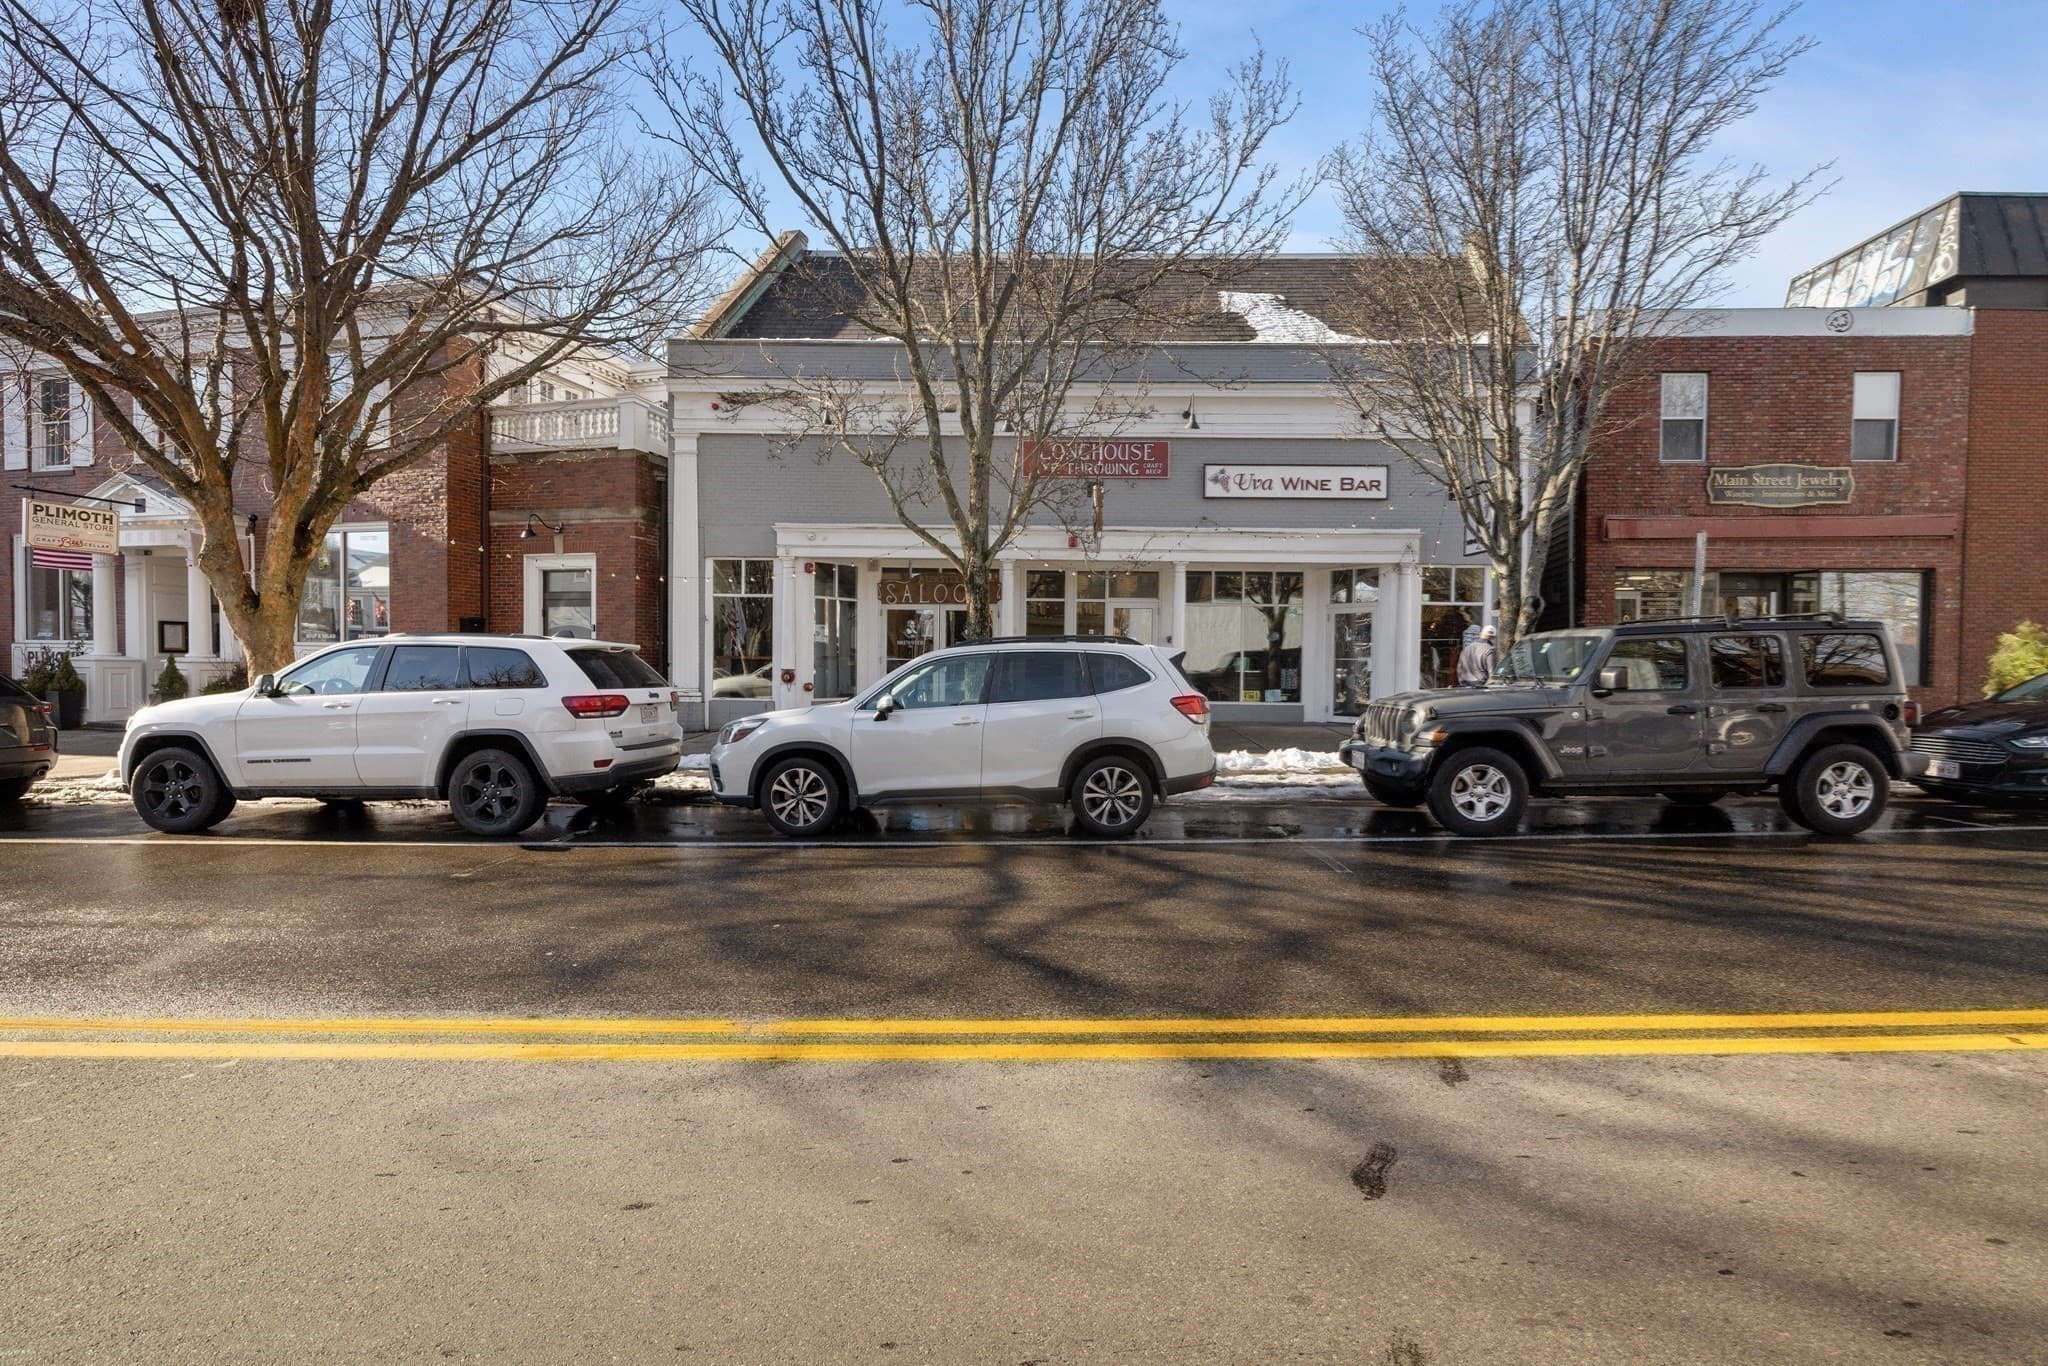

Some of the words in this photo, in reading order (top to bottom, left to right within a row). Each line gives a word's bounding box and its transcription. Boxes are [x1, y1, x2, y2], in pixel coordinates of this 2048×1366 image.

[1040, 443, 1155, 461] LONGHOUSE
[1066, 462, 1140, 476] THROWING
[1233, 472, 1274, 491] Uva
[1280, 477, 1332, 491] WINE
[1340, 477, 1382, 492] BAR
[1713, 473, 1748, 486] Main
[1751, 472, 1792, 486] Street
[1793, 472, 1847, 491] Jewelry
[32, 503, 114, 525] PLIMOTH
[31, 515, 81, 529] GENERAL
[82, 522, 114, 533] STORE
[885, 583, 966, 604] SALOO
[1560, 745, 1583, 754] Jeep
